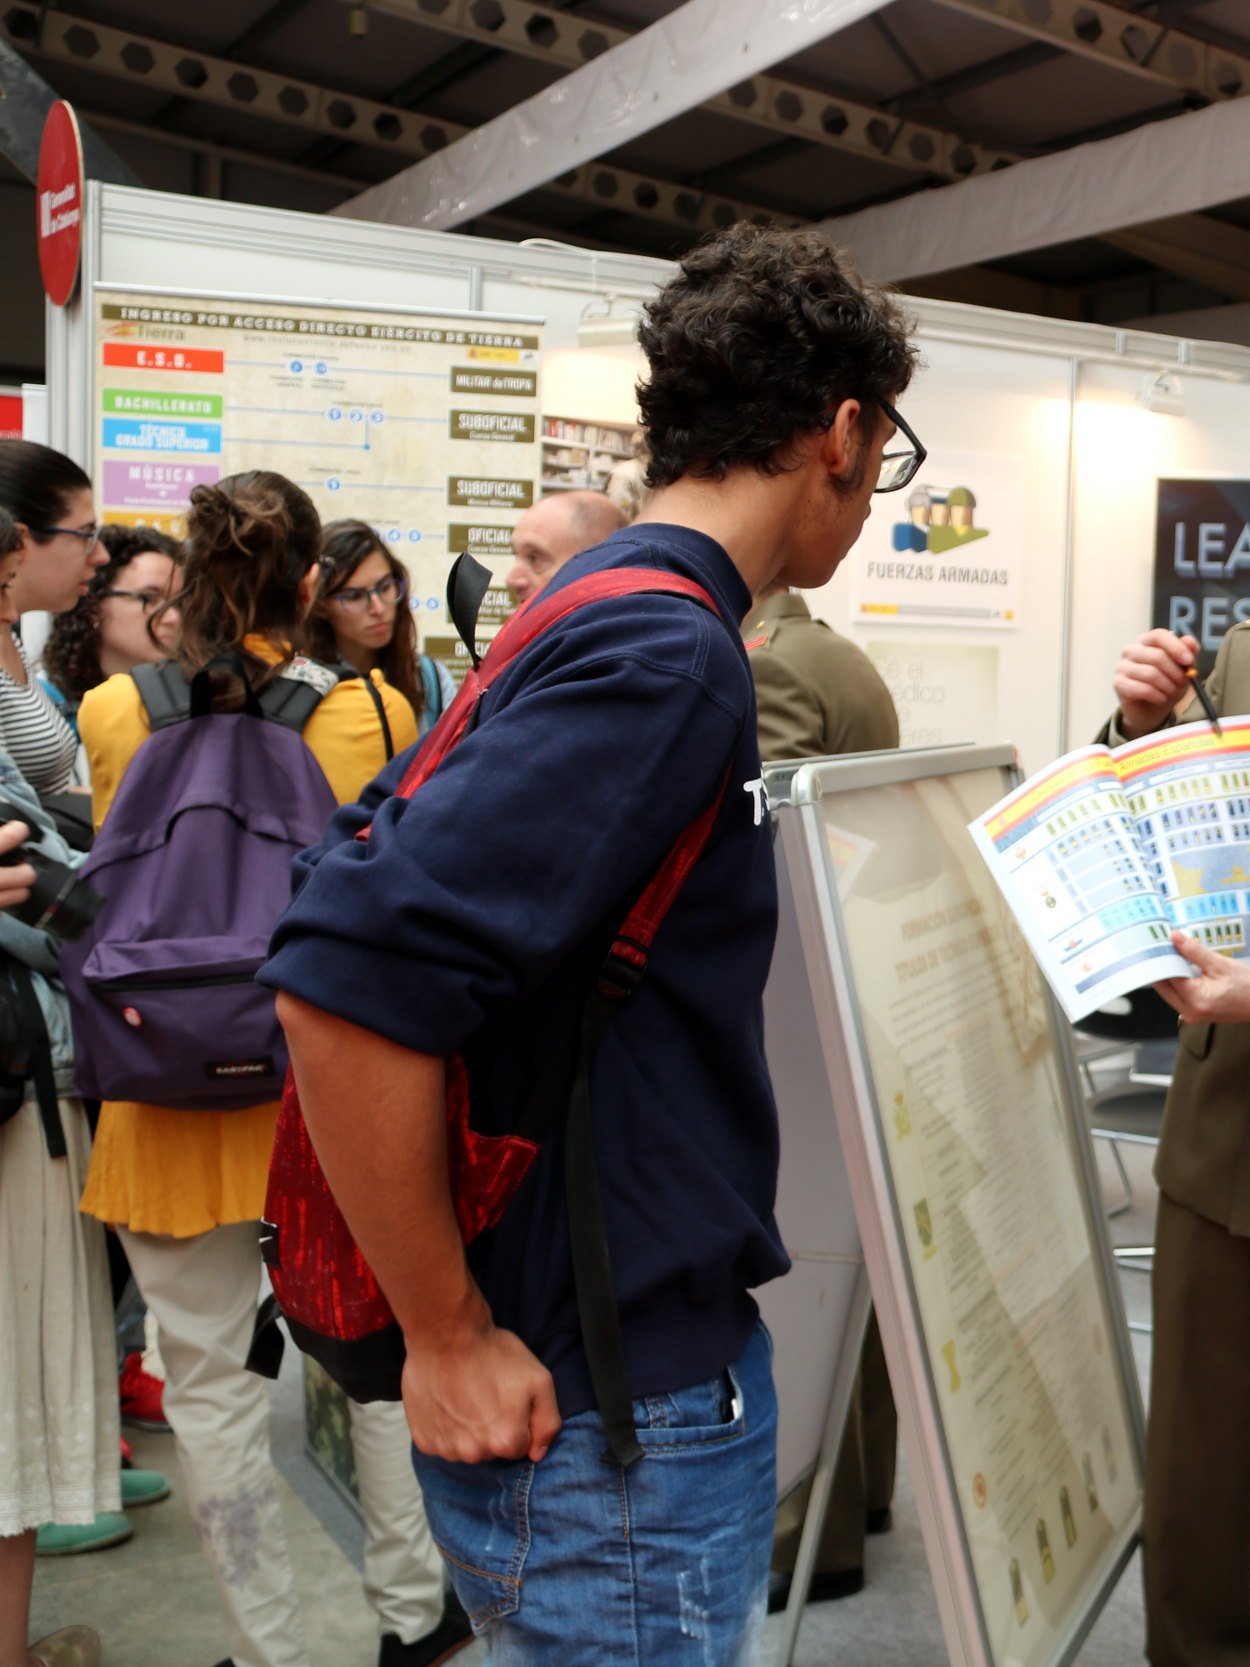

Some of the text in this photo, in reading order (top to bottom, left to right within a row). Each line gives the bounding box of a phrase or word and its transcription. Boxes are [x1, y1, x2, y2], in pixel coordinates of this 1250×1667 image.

[120, 307, 193, 324] INGRESO
[197, 314, 230, 328] POR
[232, 316, 296, 332] ACCESO
[298, 320, 367, 338] DIRECTO
[446, 333, 466, 344] DE
[468, 334, 524, 348] TIERRA
[137, 325, 186, 341] Tierra
[455, 374, 493, 389] MILITAR
[114, 395, 213, 415] BACHILLERATO
[458, 413, 528, 433] SUBOFICIAL
[115, 433, 209, 451] GRADO SUPERIOR
[128, 464, 195, 484] MÚSICA
[456, 480, 526, 499] SUBOFICIAL
[467, 527, 511, 543] OFICIAL
[867, 561, 1009, 586] FUERZAS ARMADAS
[890, 684, 945, 704] édico
[1119, 751, 1162, 773] Armadas
[1162, 735, 1216, 757] Españolas
